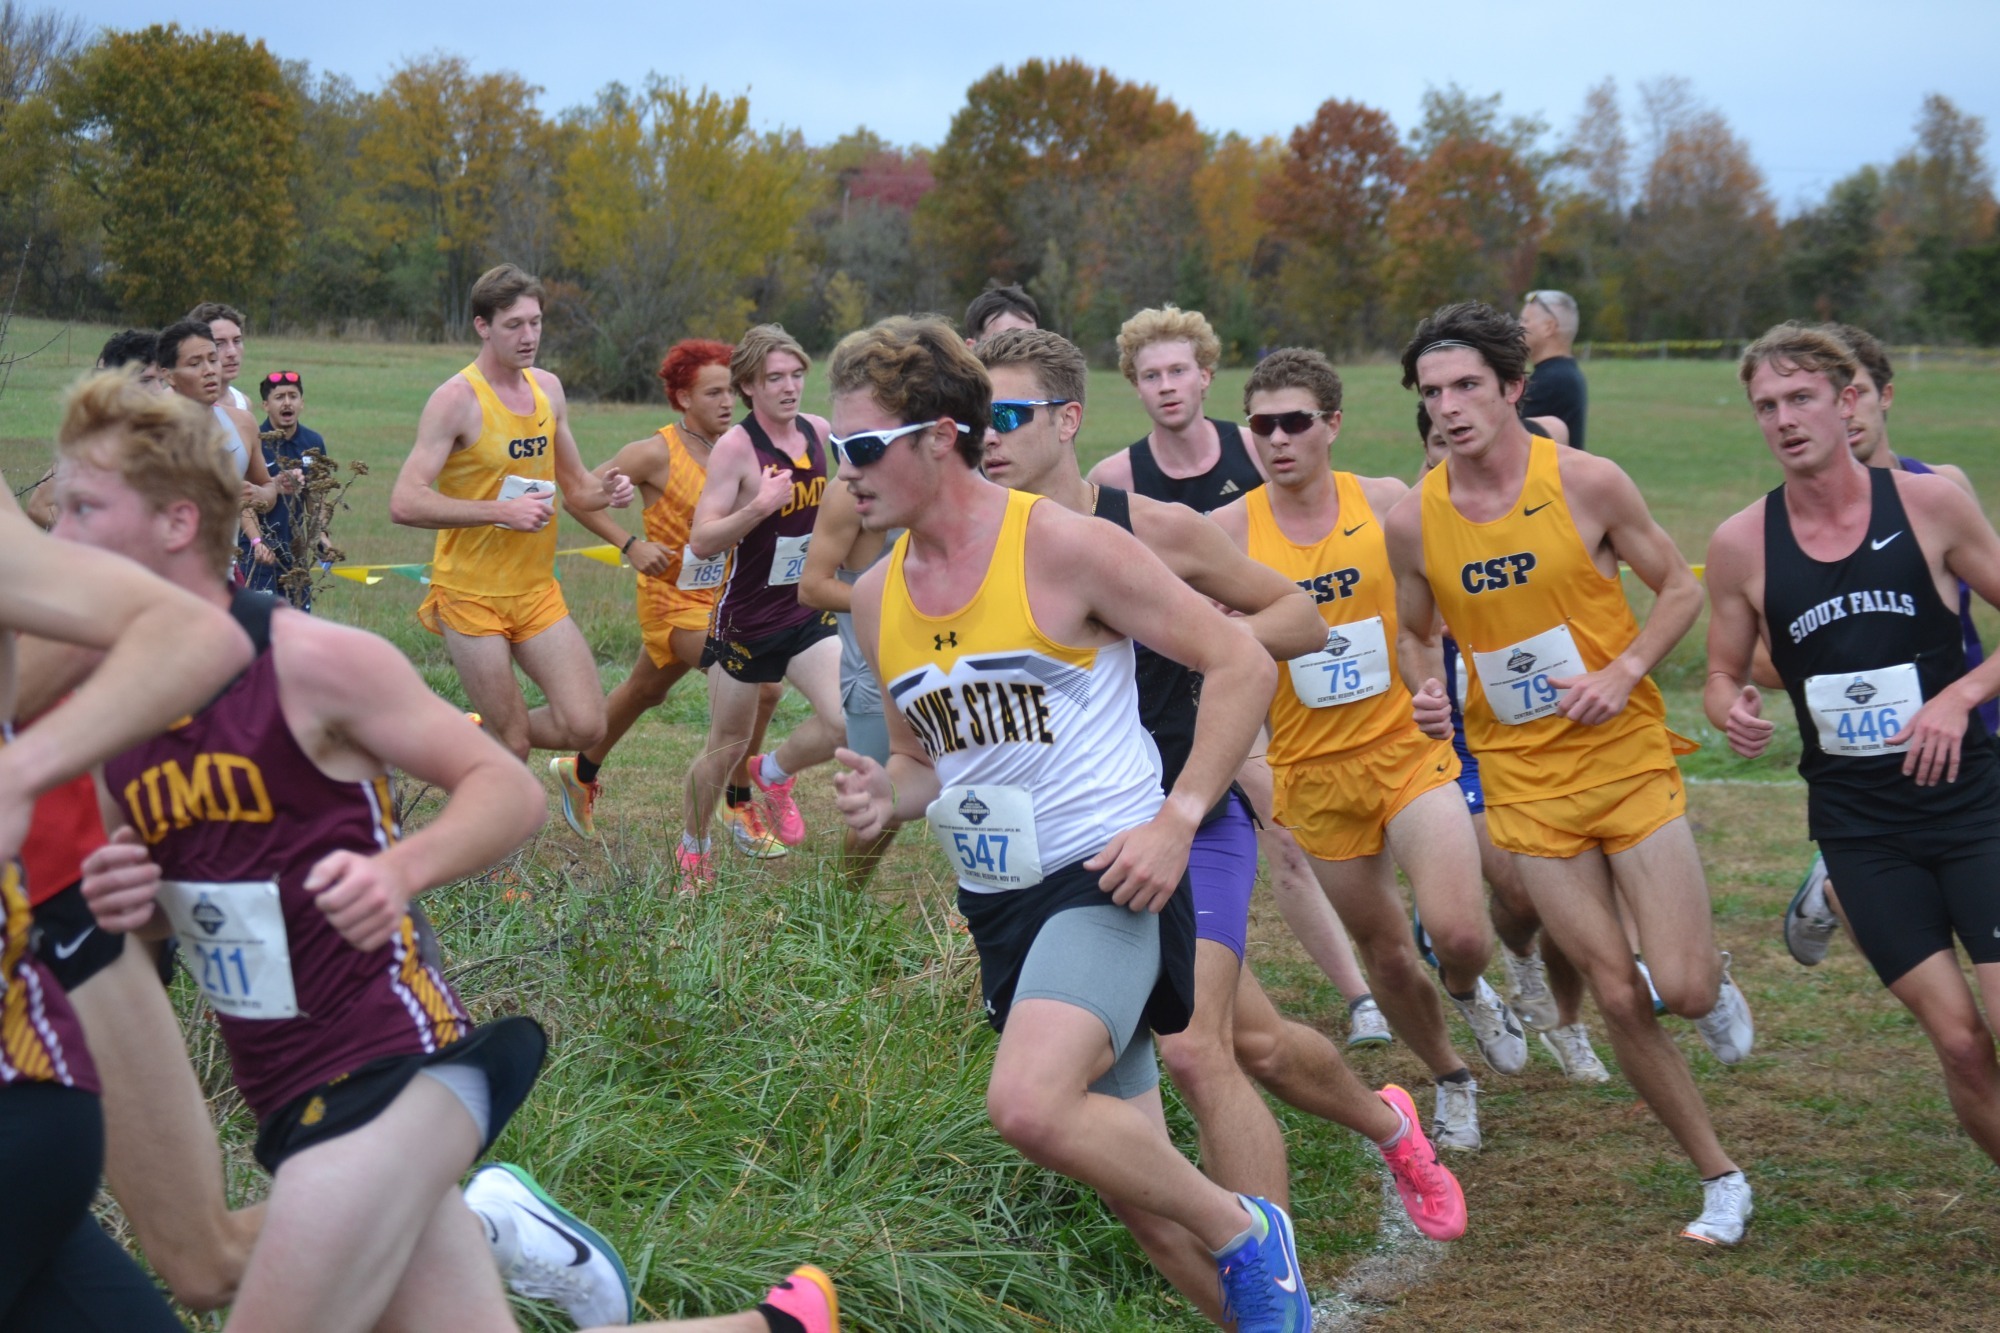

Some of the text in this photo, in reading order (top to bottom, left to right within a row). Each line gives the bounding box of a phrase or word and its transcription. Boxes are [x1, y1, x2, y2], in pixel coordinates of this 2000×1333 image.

[508, 435, 548, 459] CSP
[694, 563, 723, 582] 185
[1460, 552, 1538, 595] CSP
[1788, 590, 1916, 644] SIOUX FALLS
[1322, 660, 1361, 694] 75
[1511, 674, 1558, 710] 79
[962, 682, 1054, 746] STATE
[1837, 708, 1902, 744] 446
[124, 752, 275, 844] UMD
[953, 832, 1009, 873] 547
[193, 943, 252, 997] 211
